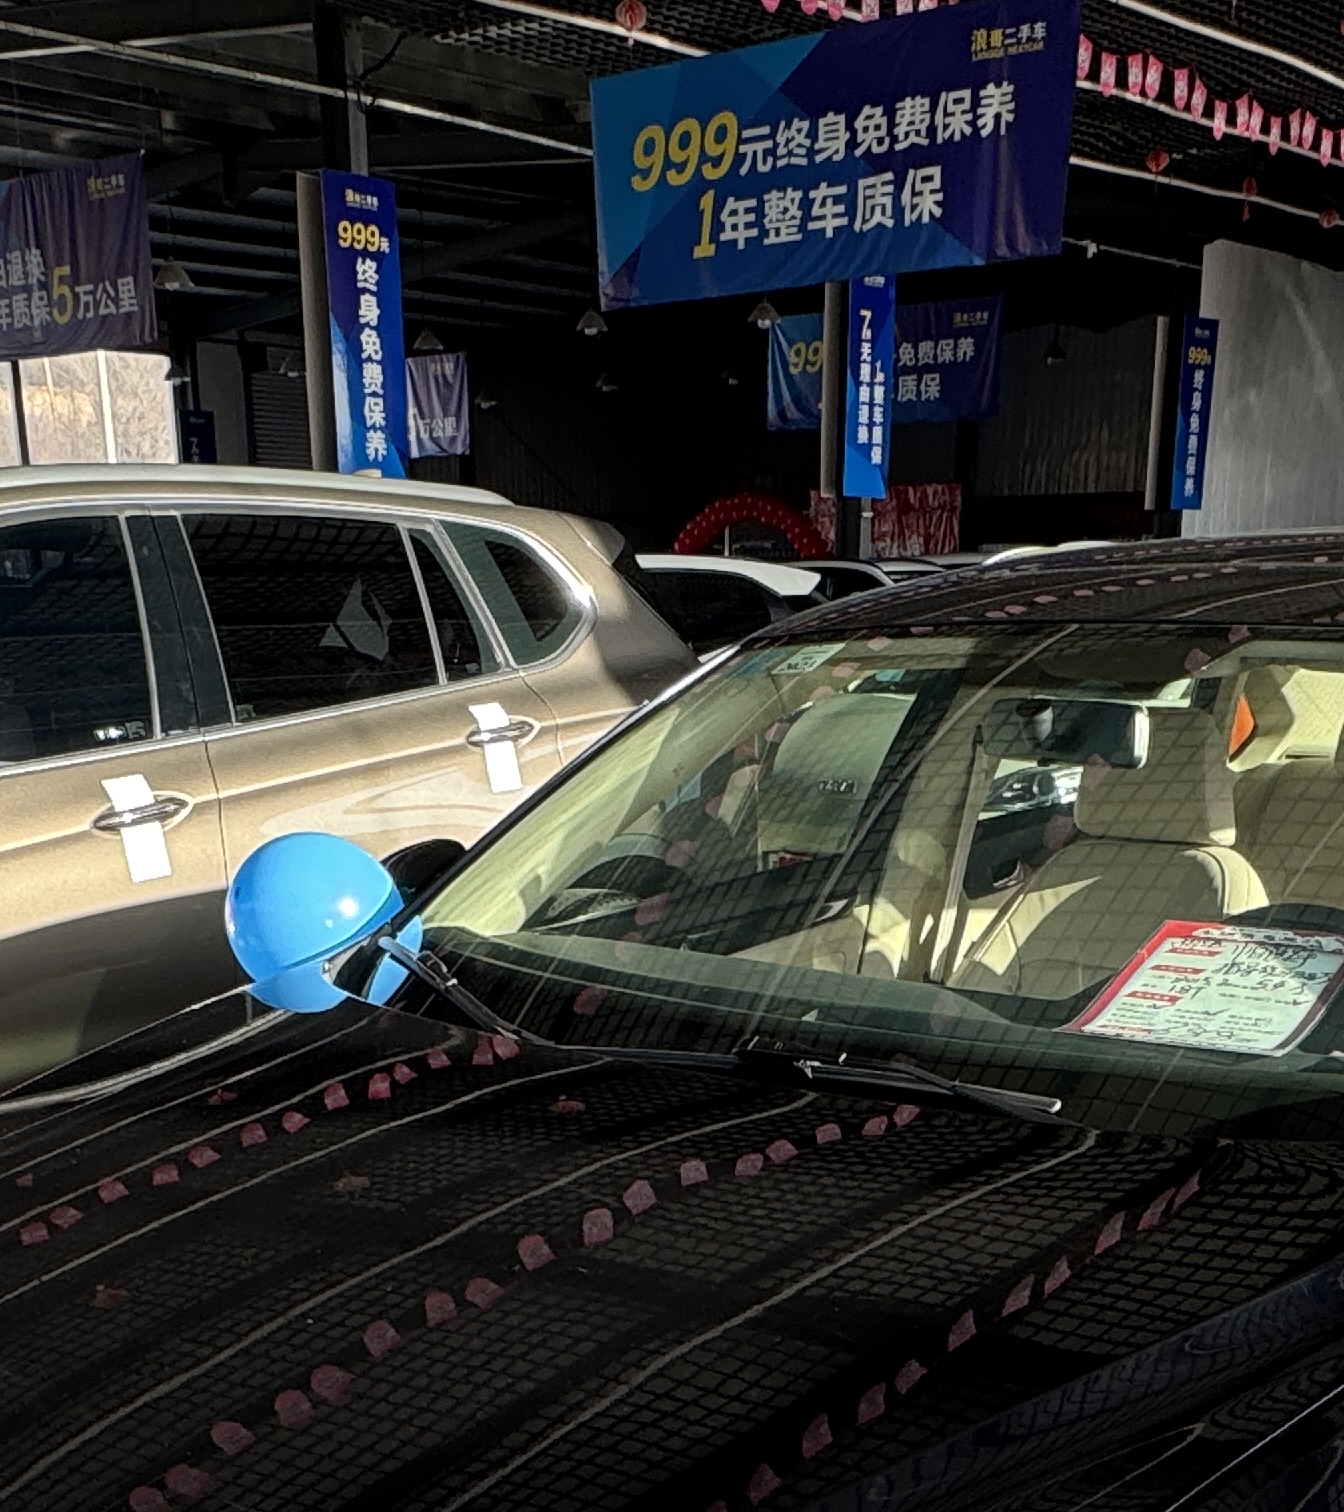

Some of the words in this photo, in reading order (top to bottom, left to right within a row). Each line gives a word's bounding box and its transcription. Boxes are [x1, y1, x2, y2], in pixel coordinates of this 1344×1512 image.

[630, 80, 1017, 192] 999元终身免费保养
[692, 164, 945, 260] 1年整车质保
[356, 257, 387, 462] 终身免费保养
